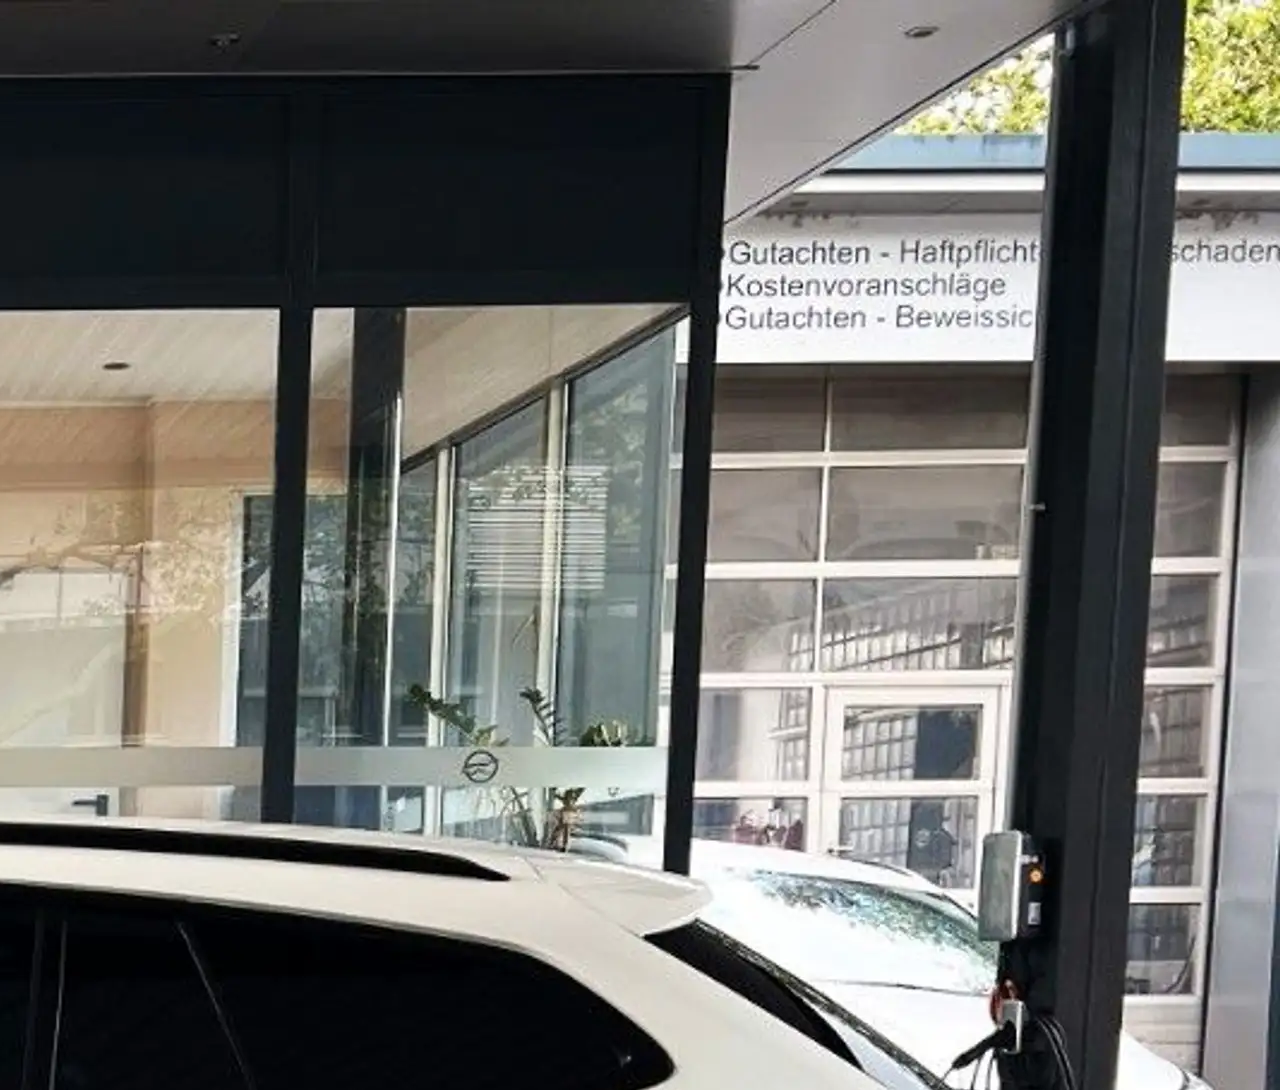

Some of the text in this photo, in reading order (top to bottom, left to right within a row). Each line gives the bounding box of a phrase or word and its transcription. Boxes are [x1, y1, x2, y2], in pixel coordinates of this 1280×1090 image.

[729, 240, 871, 265] Gutachten
[900, 239, 1042, 268] Haftpflicht
[1171, 239, 1280, 262] schaden
[726, 272, 1006, 302] Kostenvoranschläge
[725, 305, 867, 330] Gutachten
[896, 304, 1034, 330] Beweissic
